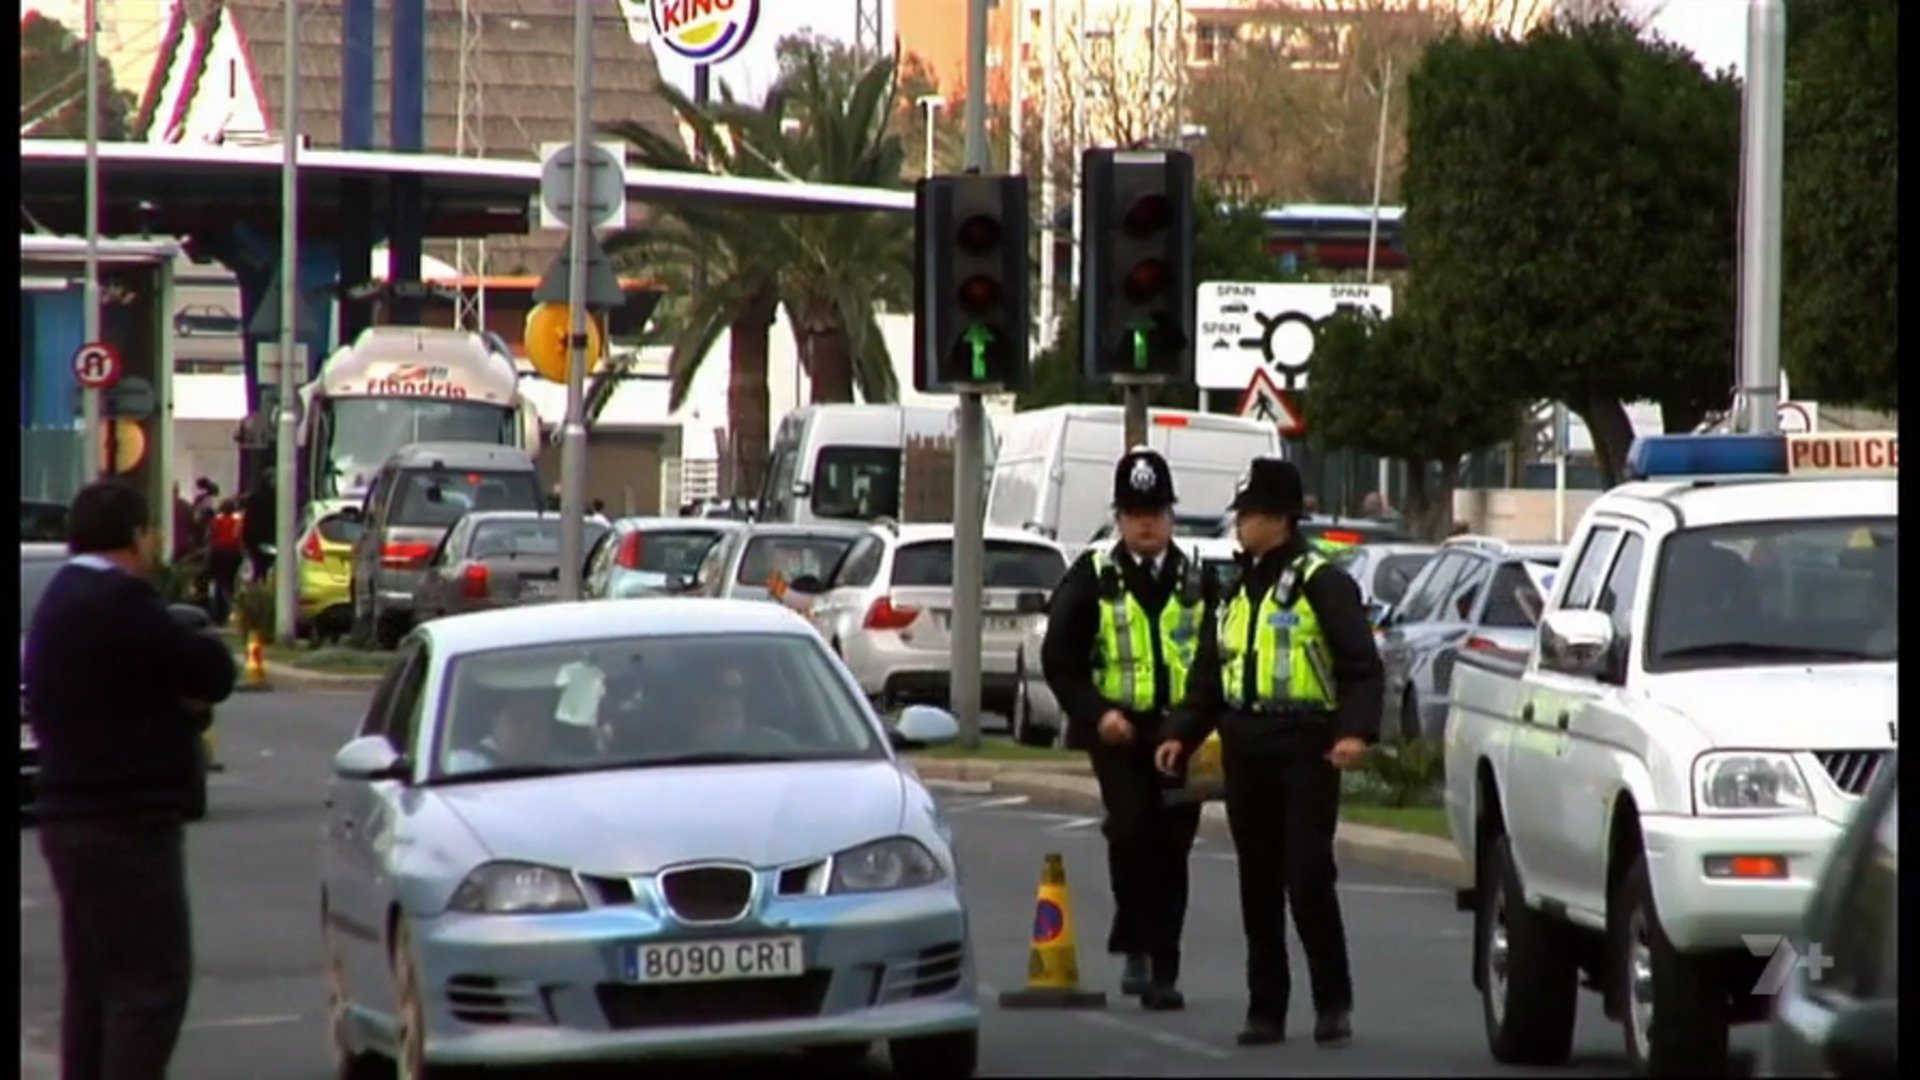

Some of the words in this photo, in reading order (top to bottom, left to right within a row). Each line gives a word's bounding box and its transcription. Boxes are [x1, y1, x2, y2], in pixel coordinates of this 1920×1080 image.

[1217, 285, 1257, 297] SPAIN
[1330, 286, 1370, 299] SPAIN
[1202, 323, 1241, 335] SPAIN
[645, 945, 725, 977] 8090
[736, 941, 794, 972] CRT
